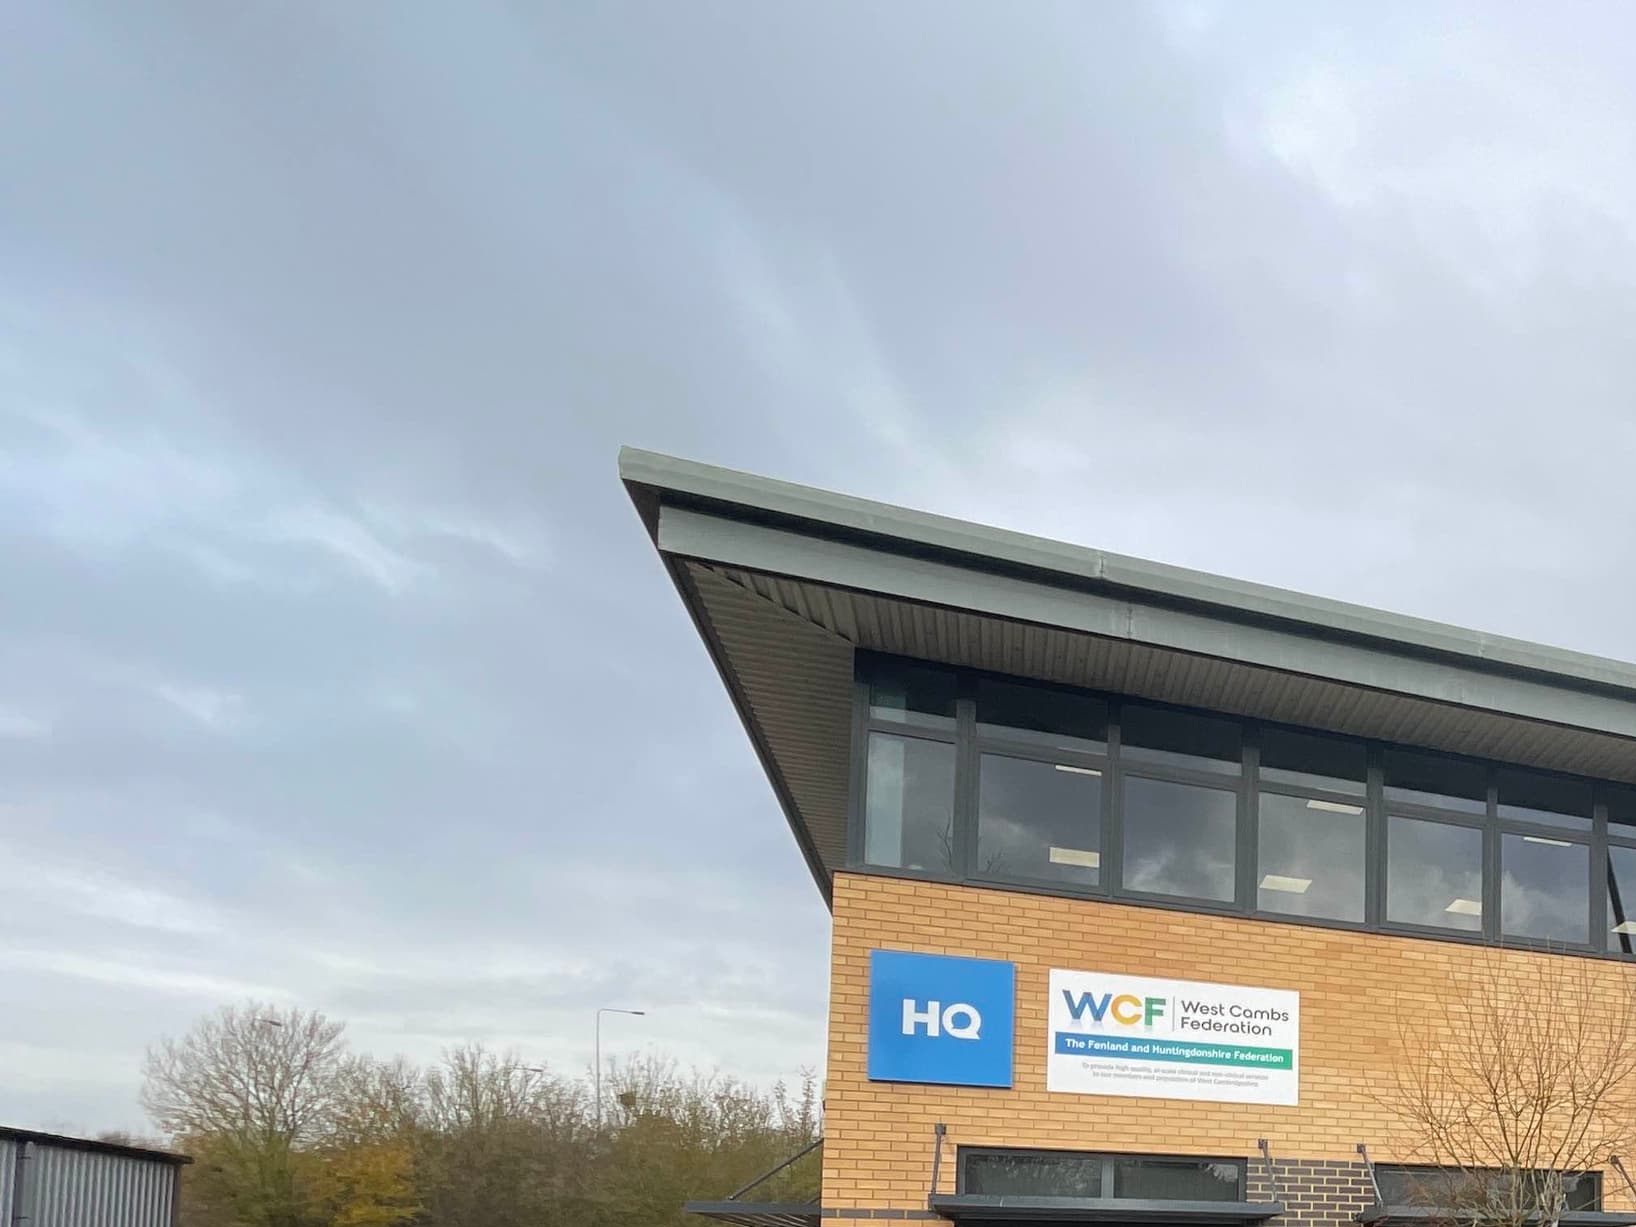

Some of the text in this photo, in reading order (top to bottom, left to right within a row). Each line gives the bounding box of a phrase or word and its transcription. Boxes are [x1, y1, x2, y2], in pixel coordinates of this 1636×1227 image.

[902, 998, 981, 1040] HQ
[1062, 989, 1167, 1026] WCF
[1180, 1000, 1290, 1022] West Cambs
[1180, 1016, 1272, 1036] Federation
[1065, 1038, 1285, 1063] The Fenland and Huntingdonshire Federation
